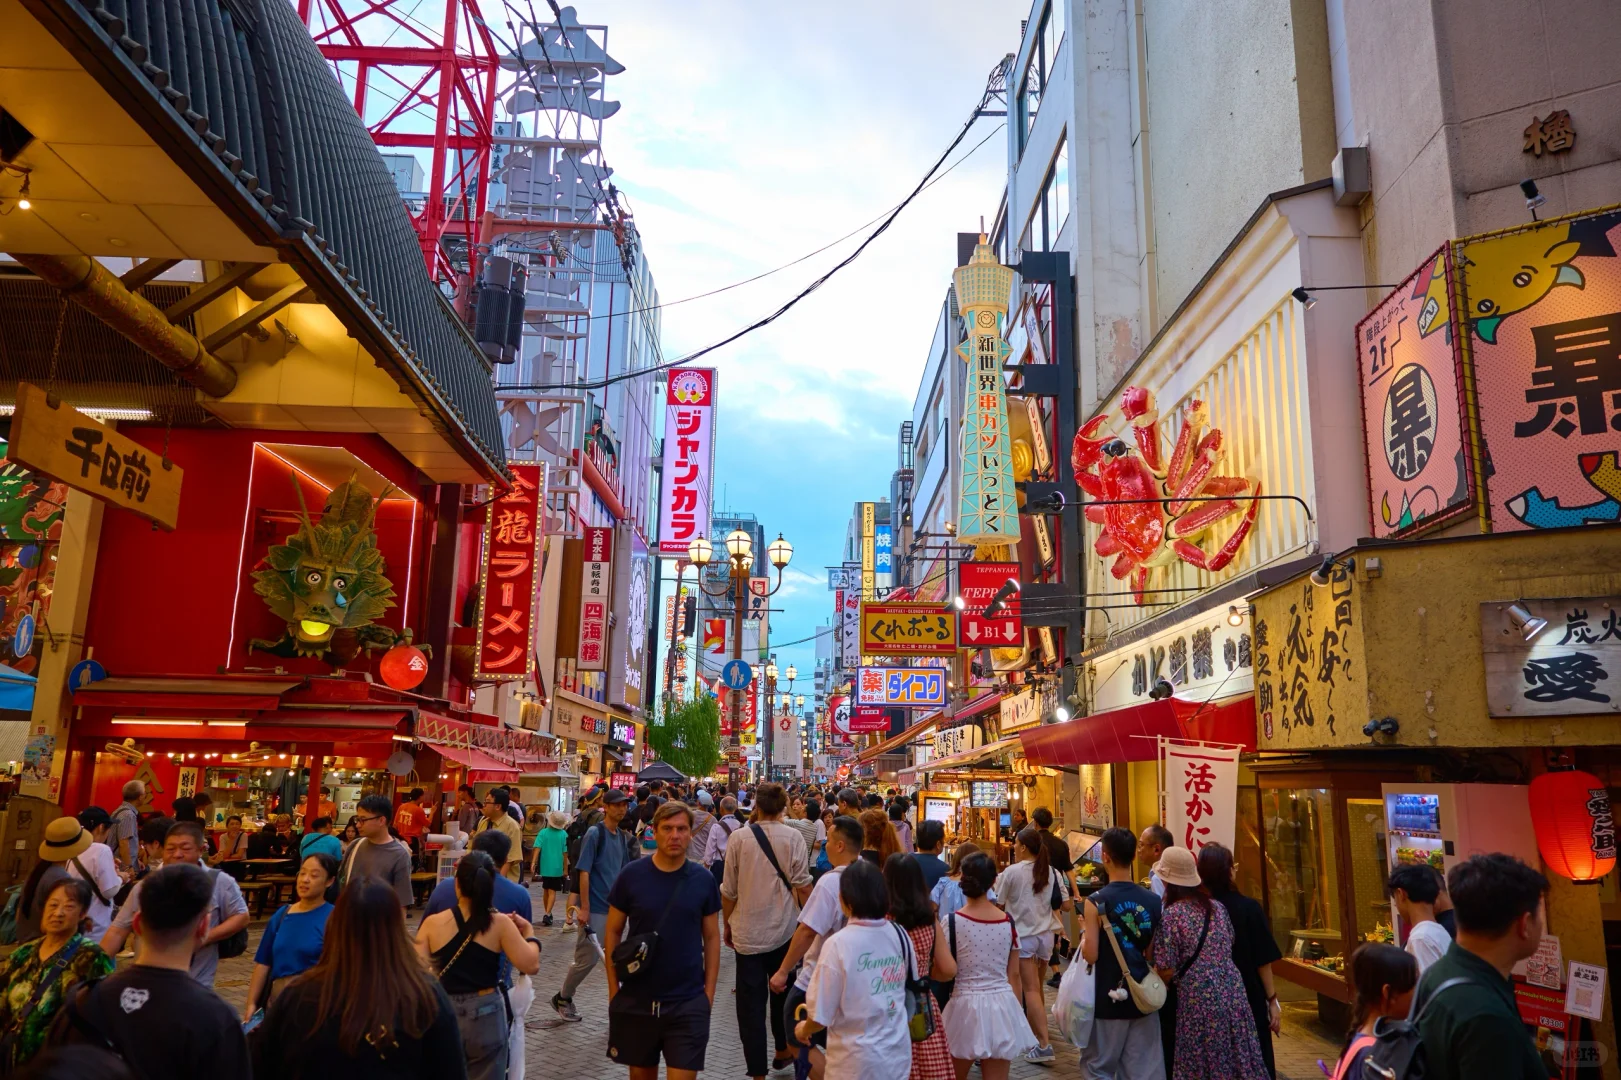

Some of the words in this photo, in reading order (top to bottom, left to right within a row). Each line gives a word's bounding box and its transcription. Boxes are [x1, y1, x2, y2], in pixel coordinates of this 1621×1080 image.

[1366, 297, 1406, 343] 階段上がって
[1369, 336, 1387, 375] 2F
[65, 427, 151, 503] 千日前
[671, 410, 702, 540] ジャンカラ
[592, 530, 604, 561] 大起水産
[876, 533, 892, 566] 焼肉
[484, 468, 536, 669] 金龍ラーメン
[591, 563, 601, 594] 回転寿司
[870, 615, 951, 642] くれおーる
[984, 627, 999, 638] B1
[408, 655, 425, 670] 金
[1256, 618, 1274, 714] 愛之助
[1522, 651, 1611, 703] 愛
[861, 669, 883, 693] 薬
[889, 672, 942, 700] ダイコク
[1539, 994, 1556, 1003] Happy
[1540, 1016, 1565, 1029] ¥3300
